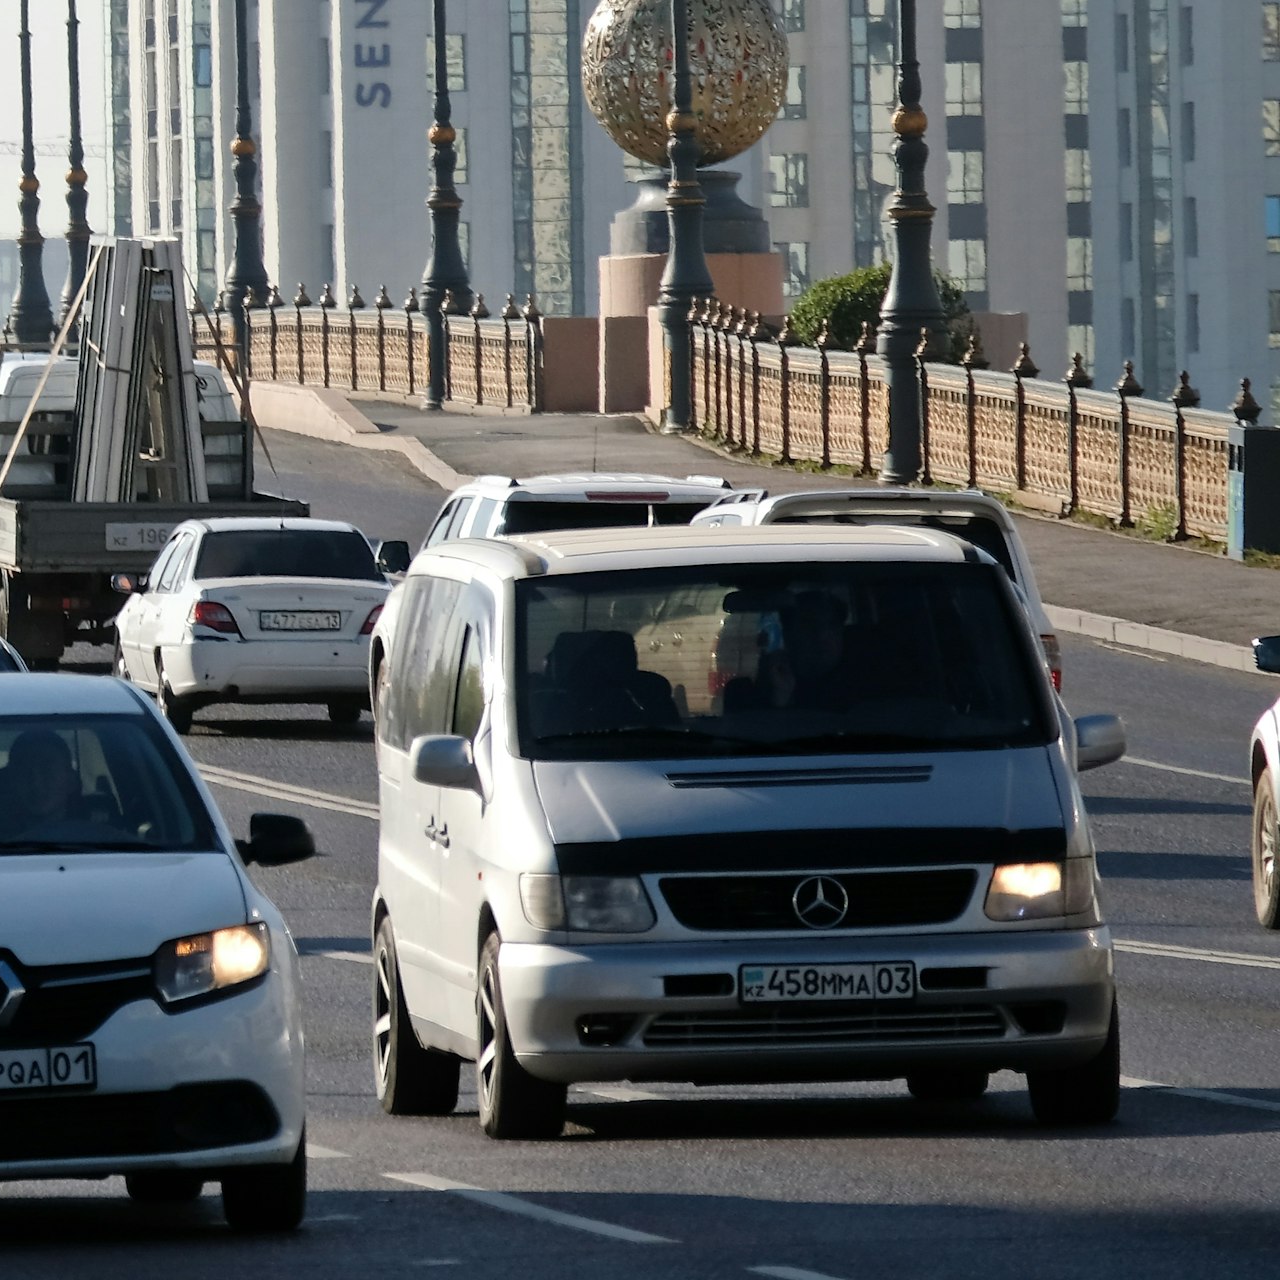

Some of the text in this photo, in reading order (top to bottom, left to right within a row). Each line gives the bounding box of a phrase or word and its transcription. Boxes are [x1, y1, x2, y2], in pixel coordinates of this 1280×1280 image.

[113, 528, 168, 546] KZ 196
[745, 985, 765, 997] KZ
[877, 967, 911, 994] 03
[52, 1050, 90, 1082] 01
